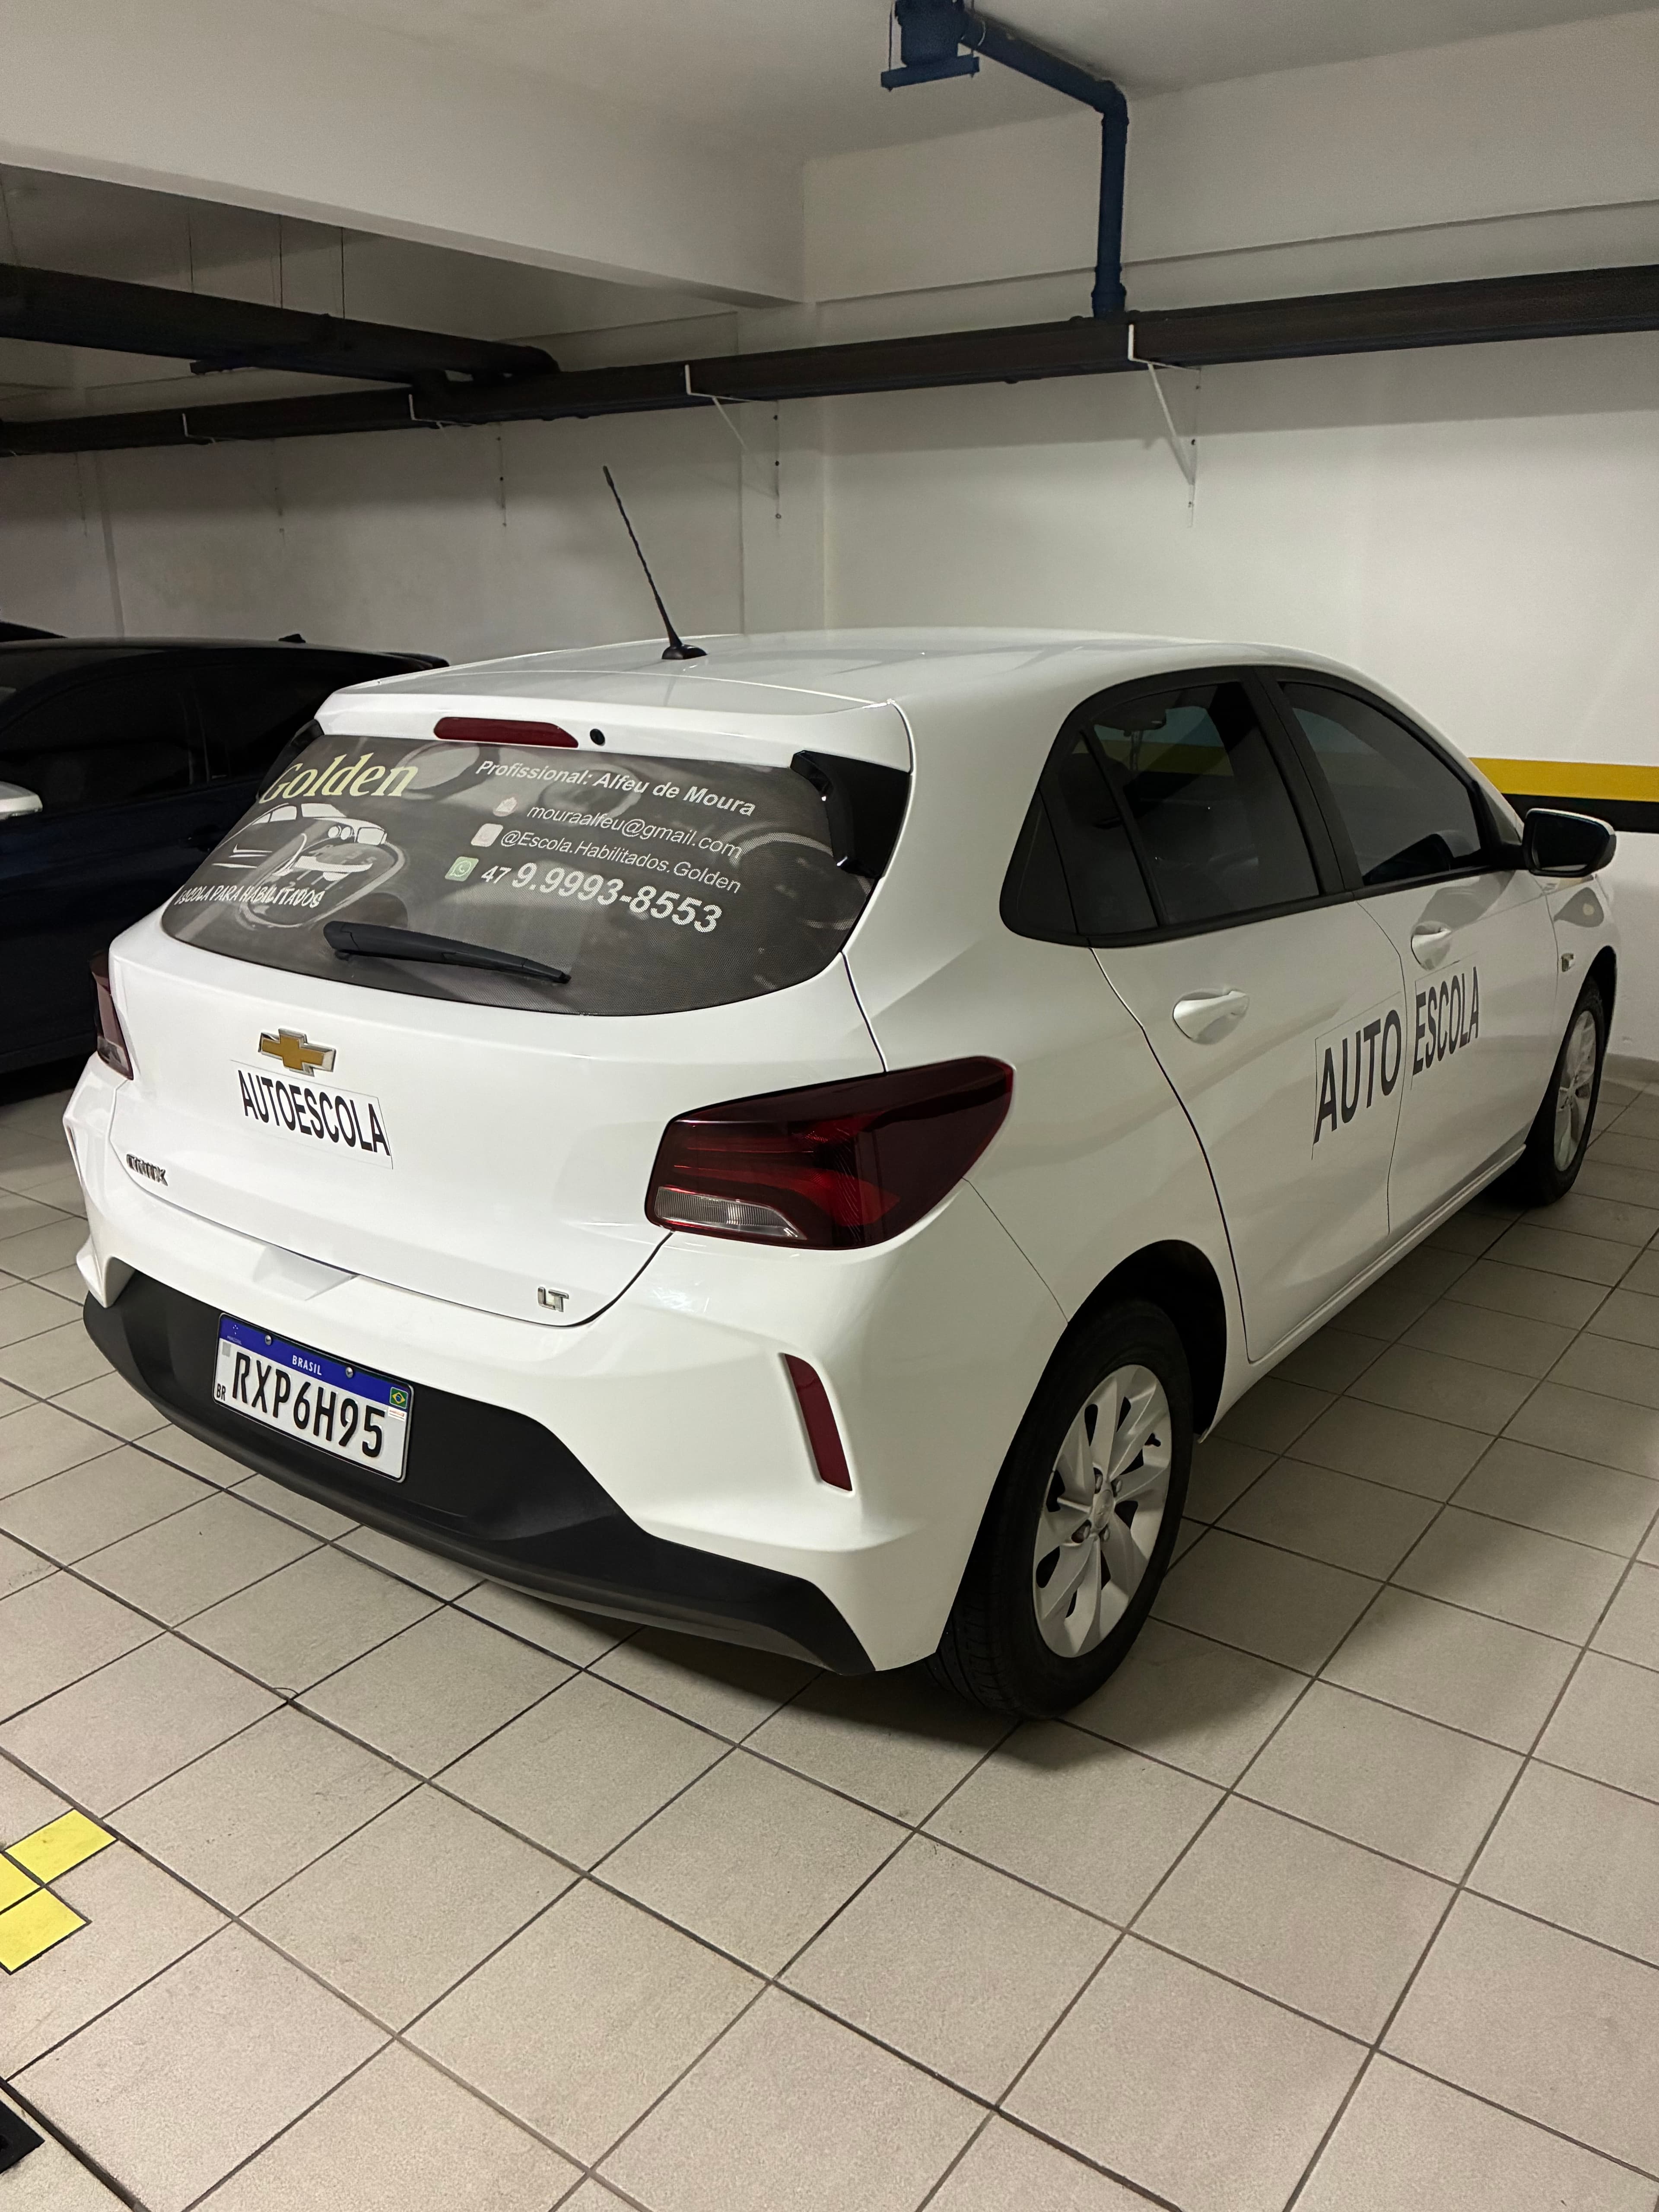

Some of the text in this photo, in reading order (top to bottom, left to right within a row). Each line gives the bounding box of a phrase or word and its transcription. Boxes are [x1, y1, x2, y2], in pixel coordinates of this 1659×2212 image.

[259, 753, 419, 804] Golden
[475, 760, 756, 816] Profissional: Alfeu de Moura
[527, 806, 743, 859] mouraalfeu@gmail.com
[174, 884, 325, 908] ESCOLA PARA HABILITADOS
[481, 862, 722, 933] 47 9.9993-8553
[1313, 966, 1479, 1145] AUTO ESCOLA
[238, 1069, 391, 1156] AUTOESCOLA
[537, 1287, 569, 1313] LT
[292, 1354, 322, 1376] BRASIL
[216, 1382, 226, 1402] BR
[232, 1352, 385, 1458] RXP6H95
